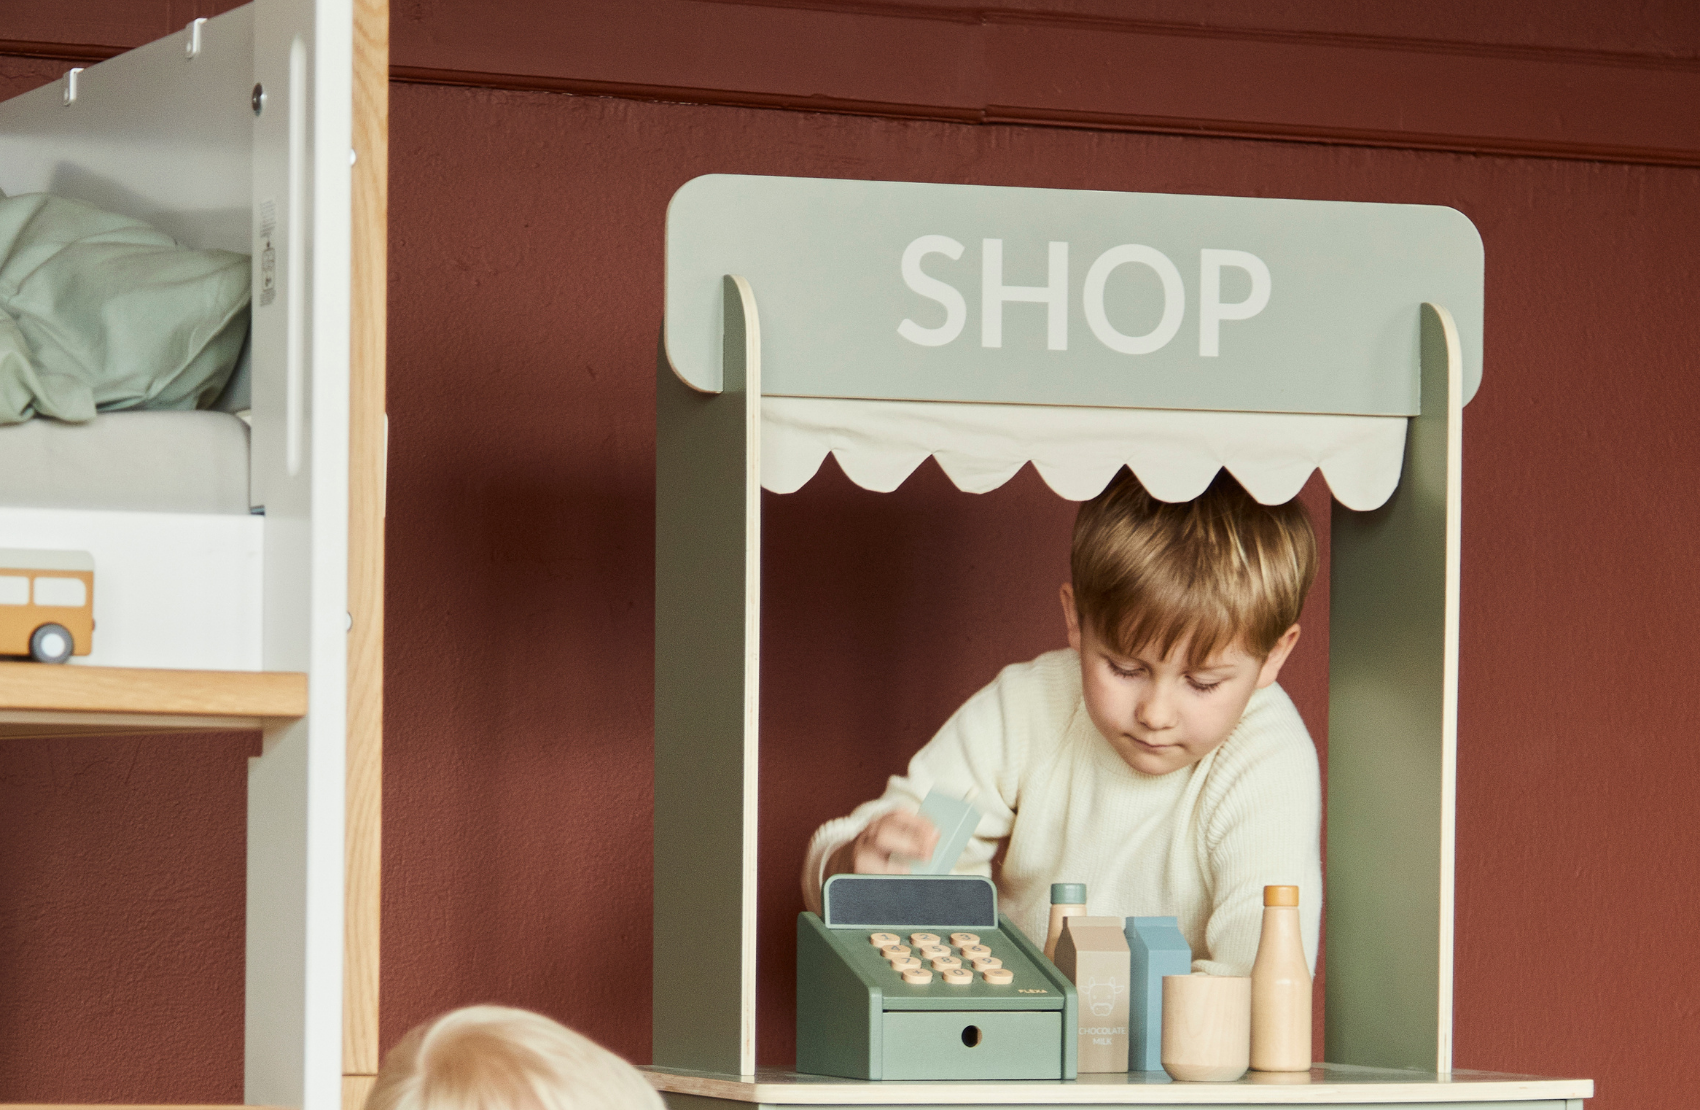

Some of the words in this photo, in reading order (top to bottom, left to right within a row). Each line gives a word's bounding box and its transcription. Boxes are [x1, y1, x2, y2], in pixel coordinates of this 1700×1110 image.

[896, 233, 1273, 358] SHOP
[1079, 1027, 1127, 1035] CHOCOLATE
[1092, 1037, 1112, 1045] MILK
